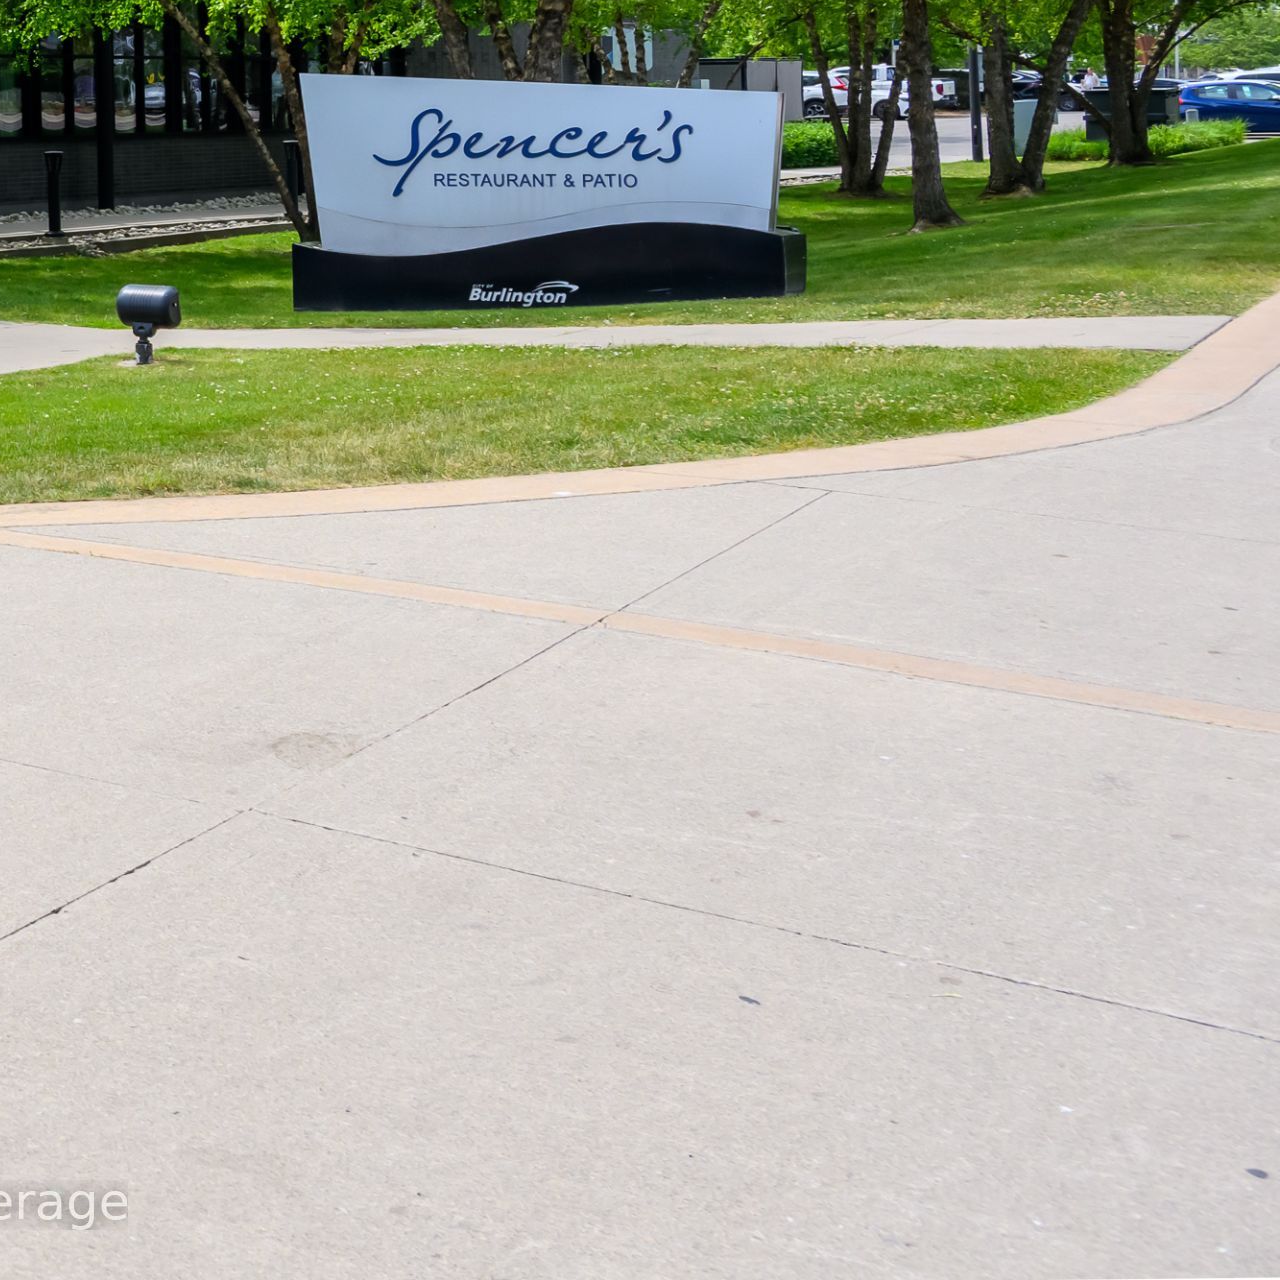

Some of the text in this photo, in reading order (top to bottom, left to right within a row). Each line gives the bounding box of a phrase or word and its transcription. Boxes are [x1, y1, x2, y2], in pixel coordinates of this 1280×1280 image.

[373, 108, 694, 197] Spencer's
[433, 173, 639, 189] RESTAURANT & PATIO
[468, 288, 567, 307] Burlington
